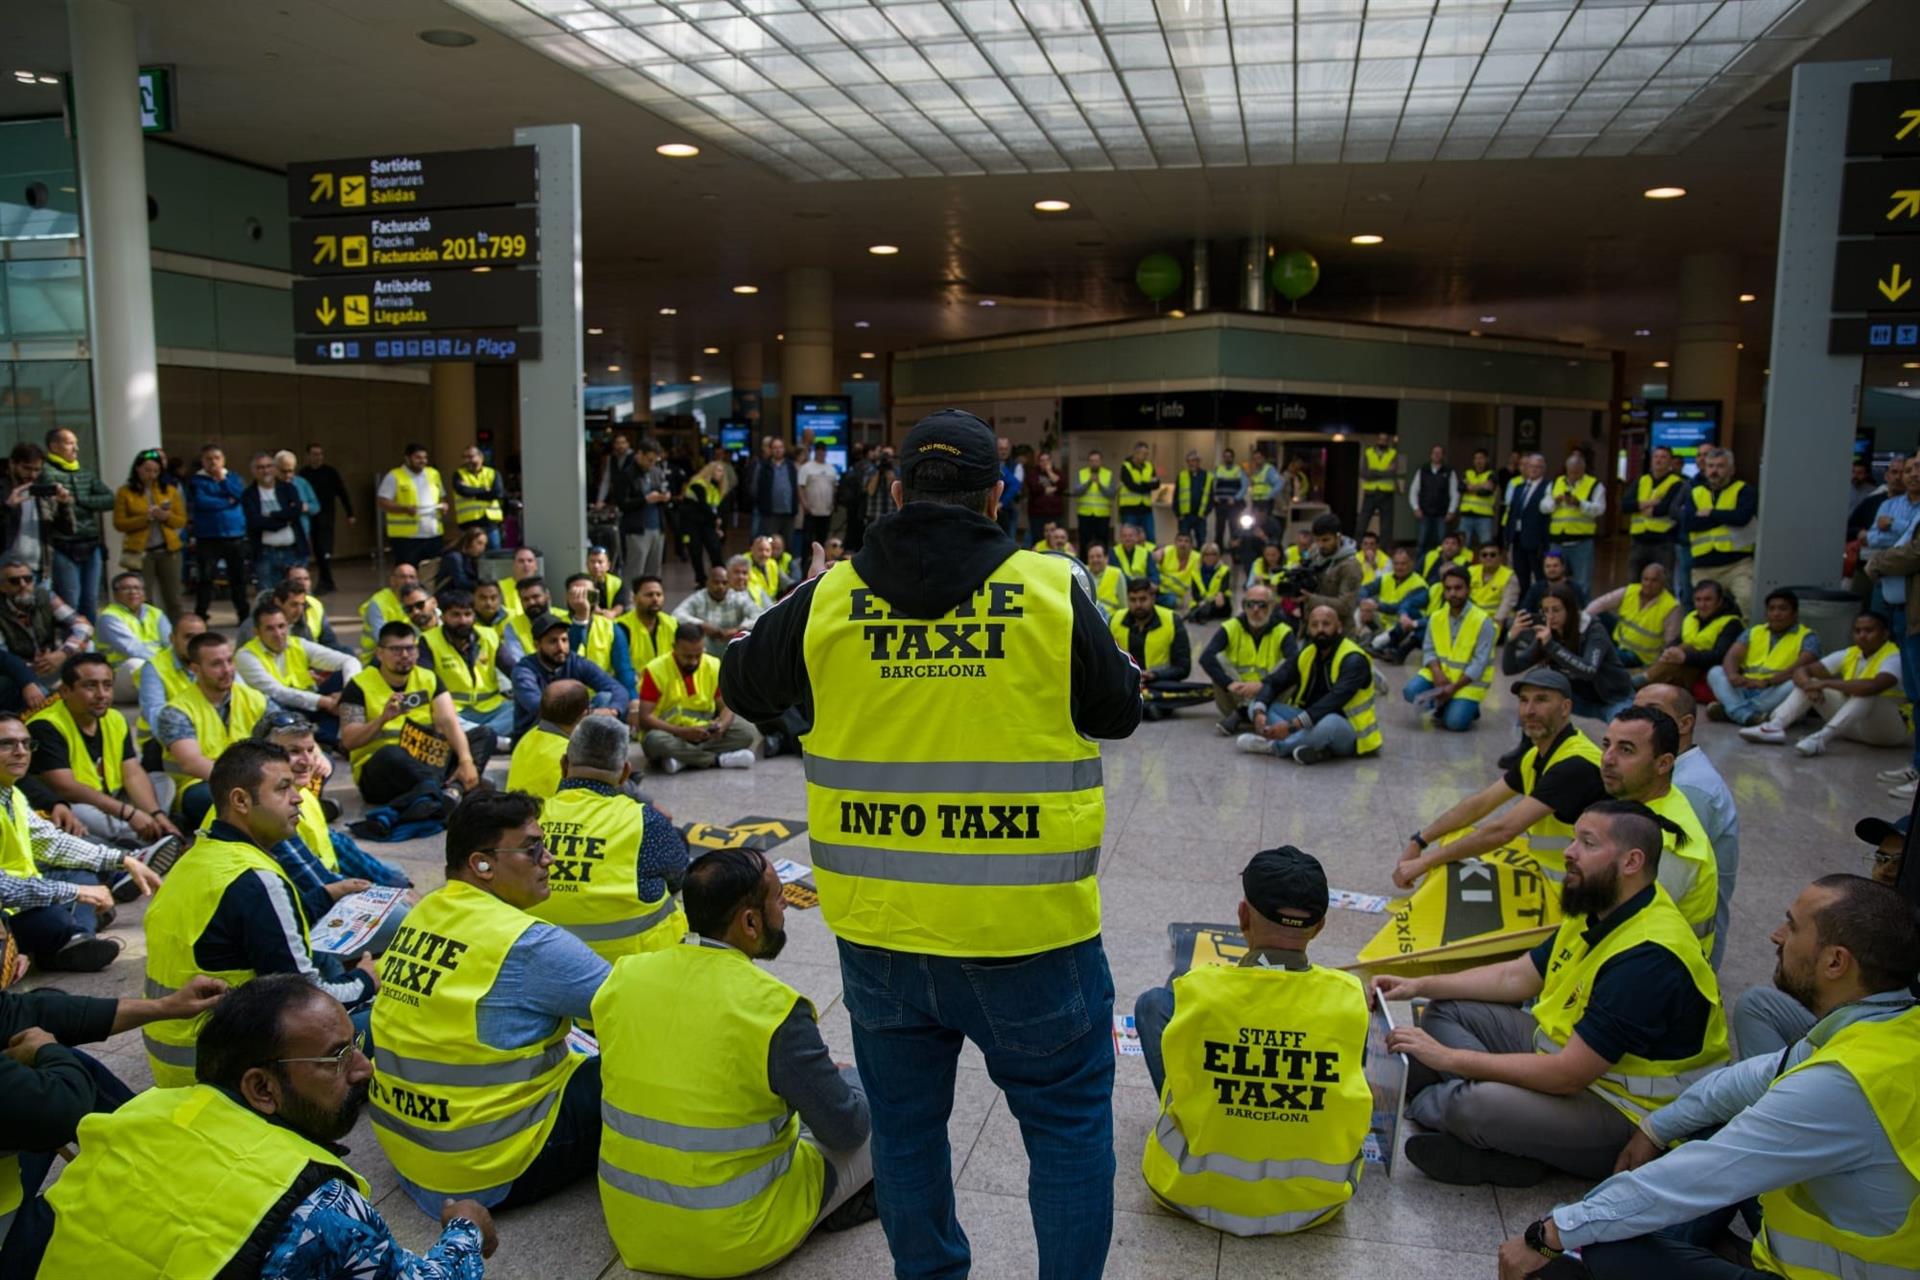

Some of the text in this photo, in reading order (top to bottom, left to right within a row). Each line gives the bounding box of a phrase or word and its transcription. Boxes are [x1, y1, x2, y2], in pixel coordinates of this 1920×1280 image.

[370, 158, 422, 173] Sortides
[370, 175, 424, 188] Departures
[371, 189, 416, 204] Salidas
[371, 217, 431, 234] Facturació
[372, 236, 415, 249] Check-in
[478, 230, 488, 243] to
[372, 234, 527, 264] Facturación 201 a 799
[373, 279, 432, 295] Arribades
[374, 295, 414, 308] Arrivals
[374, 308, 428, 325] Llegadas
[454, 337, 517, 359] La Plaça
[1161, 401, 1185, 418] info
[1281, 403, 1307, 420] info
[848, 582, 1024, 621] ETE
[863, 623, 1006, 661] TAXI
[880, 664, 987, 679] BARCELONA
[840, 800, 1040, 839] INFO TAXI
[546, 834, 607, 860] ITE
[550, 859, 593, 882] XI
[1396, 901, 1417, 953] Taxis
[389, 926, 468, 971] ELITE
[381, 955, 442, 997] TAXI
[1239, 1027, 1307, 1048] STAFF
[1203, 1040, 1340, 1083] ELITE
[1213, 1077, 1327, 1111] TAXI
[392, 1087, 451, 1123] TAXI
[1225, 1107, 1310, 1123] BARCELONA
